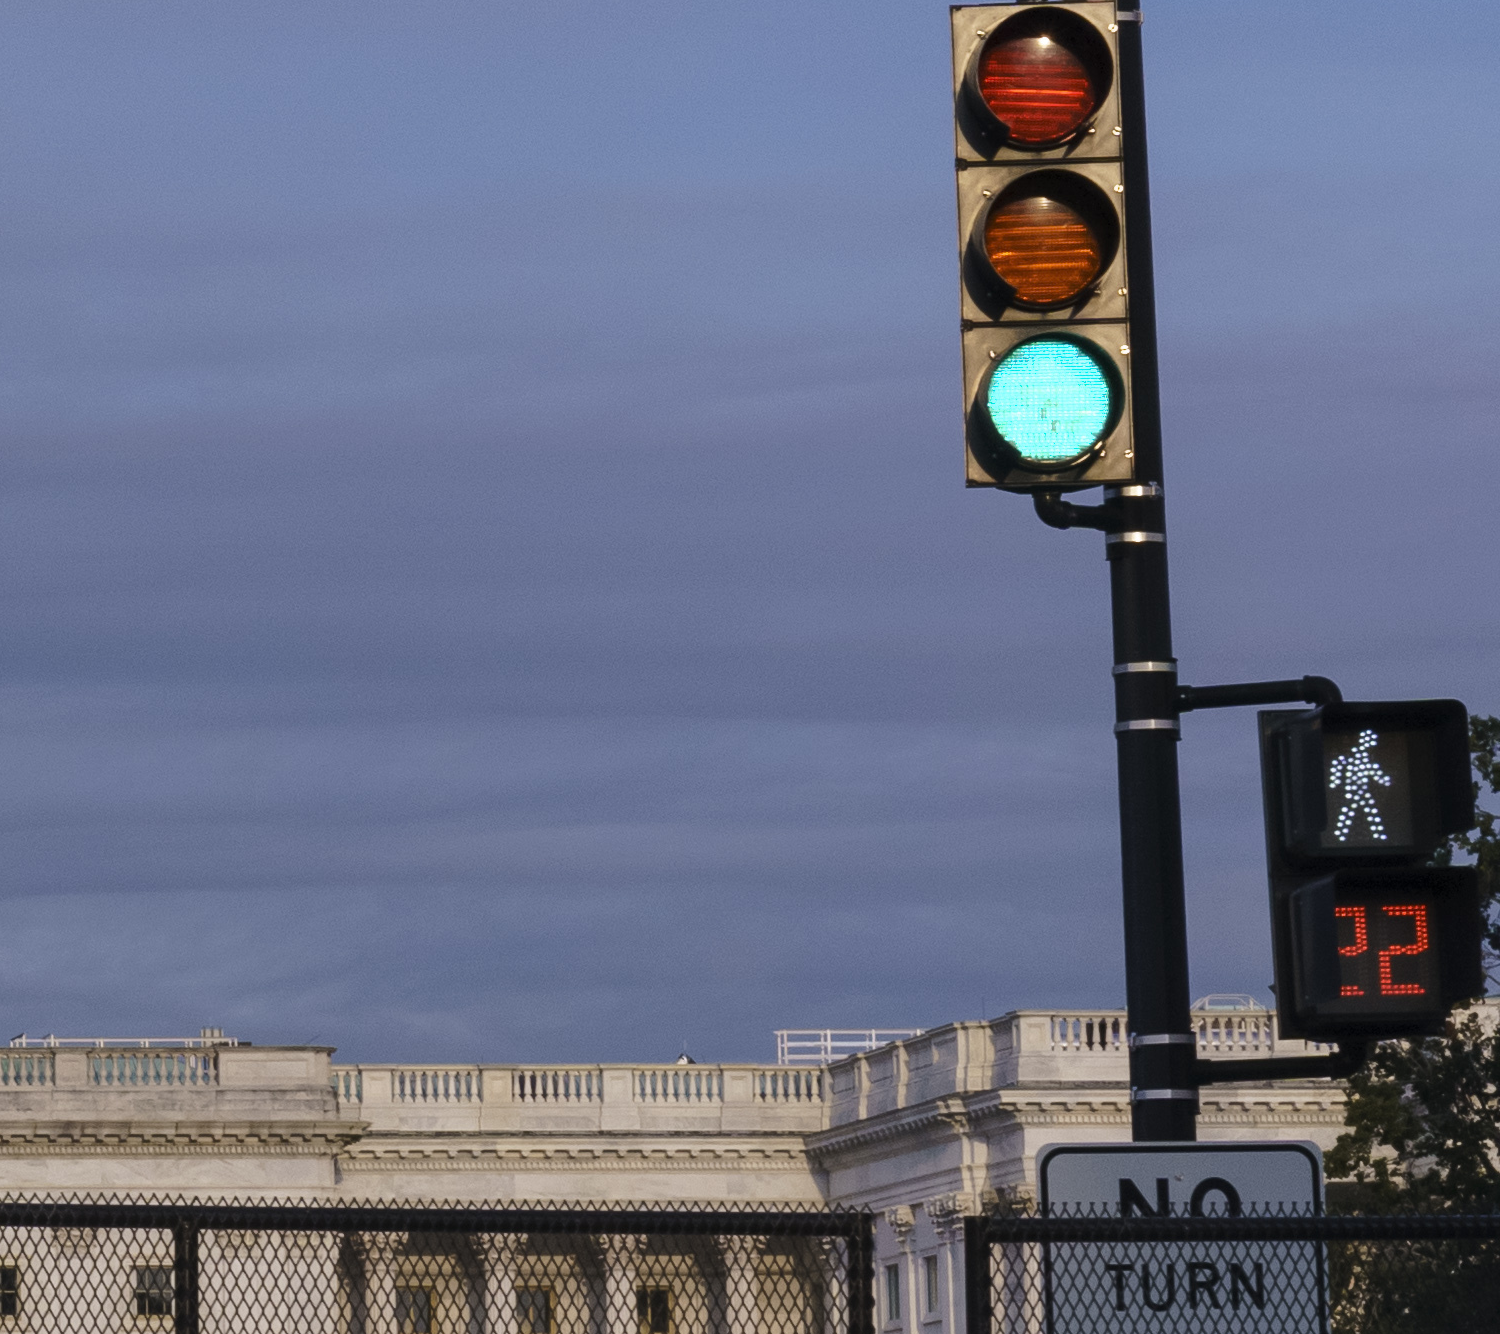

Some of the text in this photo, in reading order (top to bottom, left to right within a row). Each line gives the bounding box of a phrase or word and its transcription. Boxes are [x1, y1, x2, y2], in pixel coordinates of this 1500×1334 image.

[1334, 905, 1429, 996] 22
[1118, 1177, 1242, 1218] NO
[1105, 1261, 1265, 1312] TURN
